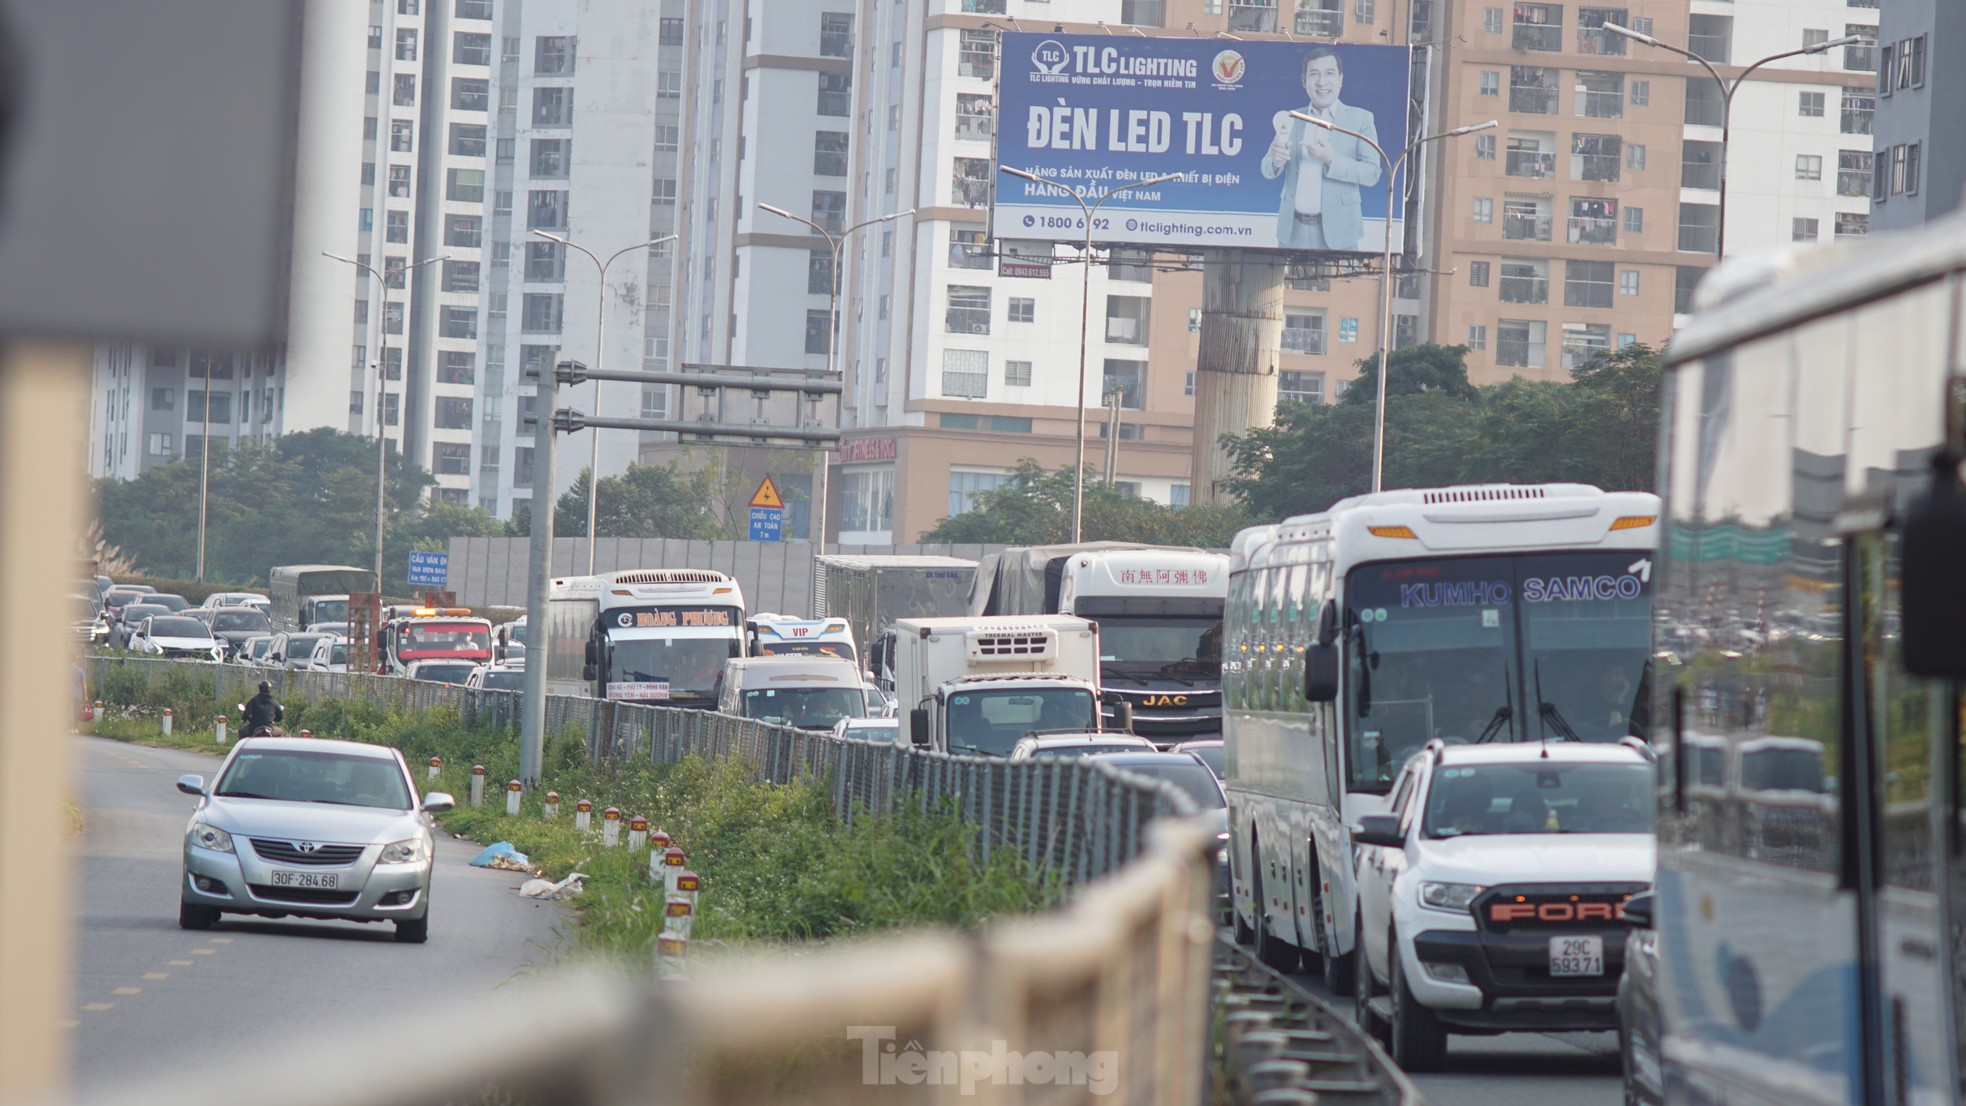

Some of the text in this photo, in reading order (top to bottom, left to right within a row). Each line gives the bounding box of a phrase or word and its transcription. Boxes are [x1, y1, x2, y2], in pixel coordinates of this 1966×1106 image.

[1042, 50, 1060, 62] TLC
[1074, 45, 1118, 74] TLC
[1120, 56, 1197, 78] LIGHTING
[1029, 74, 1070, 84] TLC LIGHTING
[1071, 75, 1092, 85] VỮNG
[1092, 76, 1111, 86] CHẤT
[1112, 78, 1136, 88] LƯỢNG
[1143, 79, 1162, 89] TRỌN
[1184, 80, 1196, 89] TIN
[1027, 97, 1243, 156] ĐÈN LED TLC
[1060, 166, 1083, 179] SẢN
[1084, 165, 1114, 180] XUẤT
[1115, 167, 1137, 181] ĐÈN
[1201, 172, 1212, 186] BỊ
[1215, 172, 1240, 187] ĐIỆN
[1075, 179, 1109, 199] ĐẦU
[1112, 188, 1134, 202] VIỆT
[1135, 190, 1161, 201] NAM
[1040, 216, 1252, 237] 1800 692 tlclighting.com.vn
[751, 509, 767, 520] CHIỀU
[411, 553, 424, 564] CẦU
[1400, 574, 1642, 608] KUMHO SAMCO
[636, 607, 729, 627] HOÀNG PHƯƠNG
[792, 627, 809, 637] VIP
[1142, 694, 1188, 706] JAC
[1490, 902, 1625, 921] FOR
[1563, 939, 1591, 956] 29C
